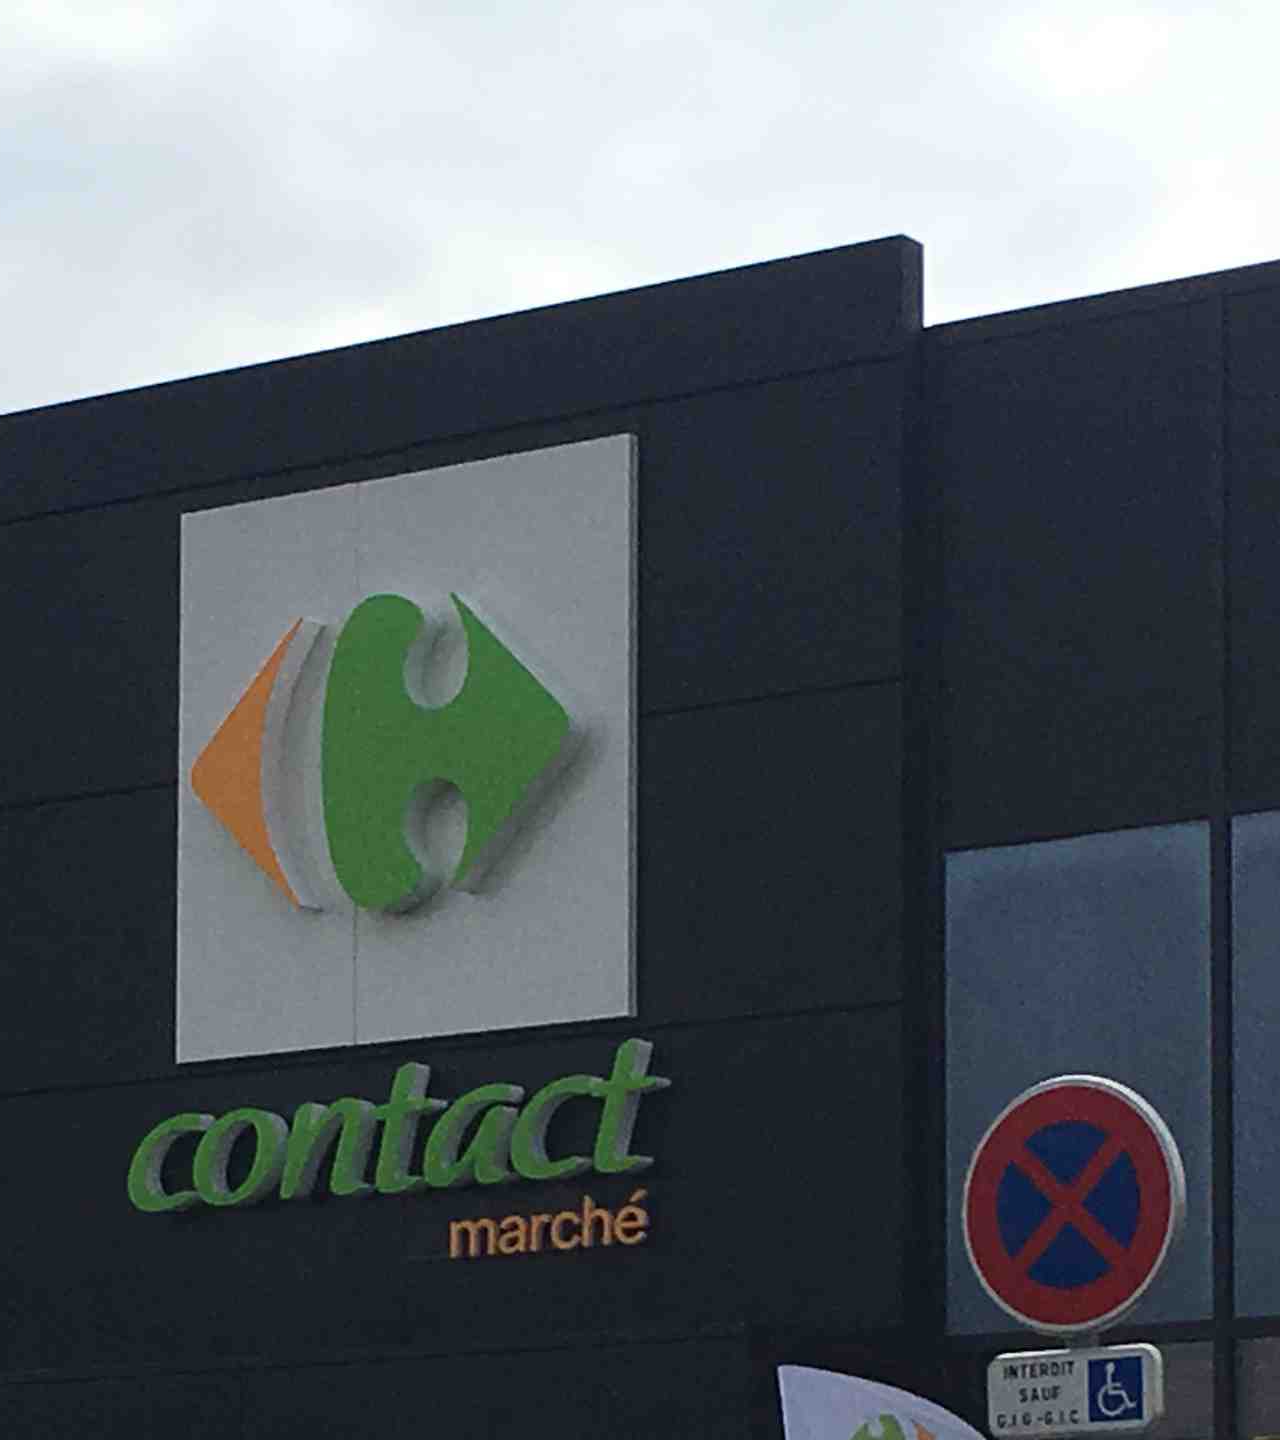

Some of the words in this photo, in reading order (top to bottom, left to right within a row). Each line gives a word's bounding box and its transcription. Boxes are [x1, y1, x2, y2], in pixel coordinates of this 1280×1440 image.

[128, 1038, 671, 1212] contact
[449, 1190, 649, 1259] marché
[1003, 1361, 1075, 1379] INTERDIT
[1018, 1386, 1061, 1402] SAUF
